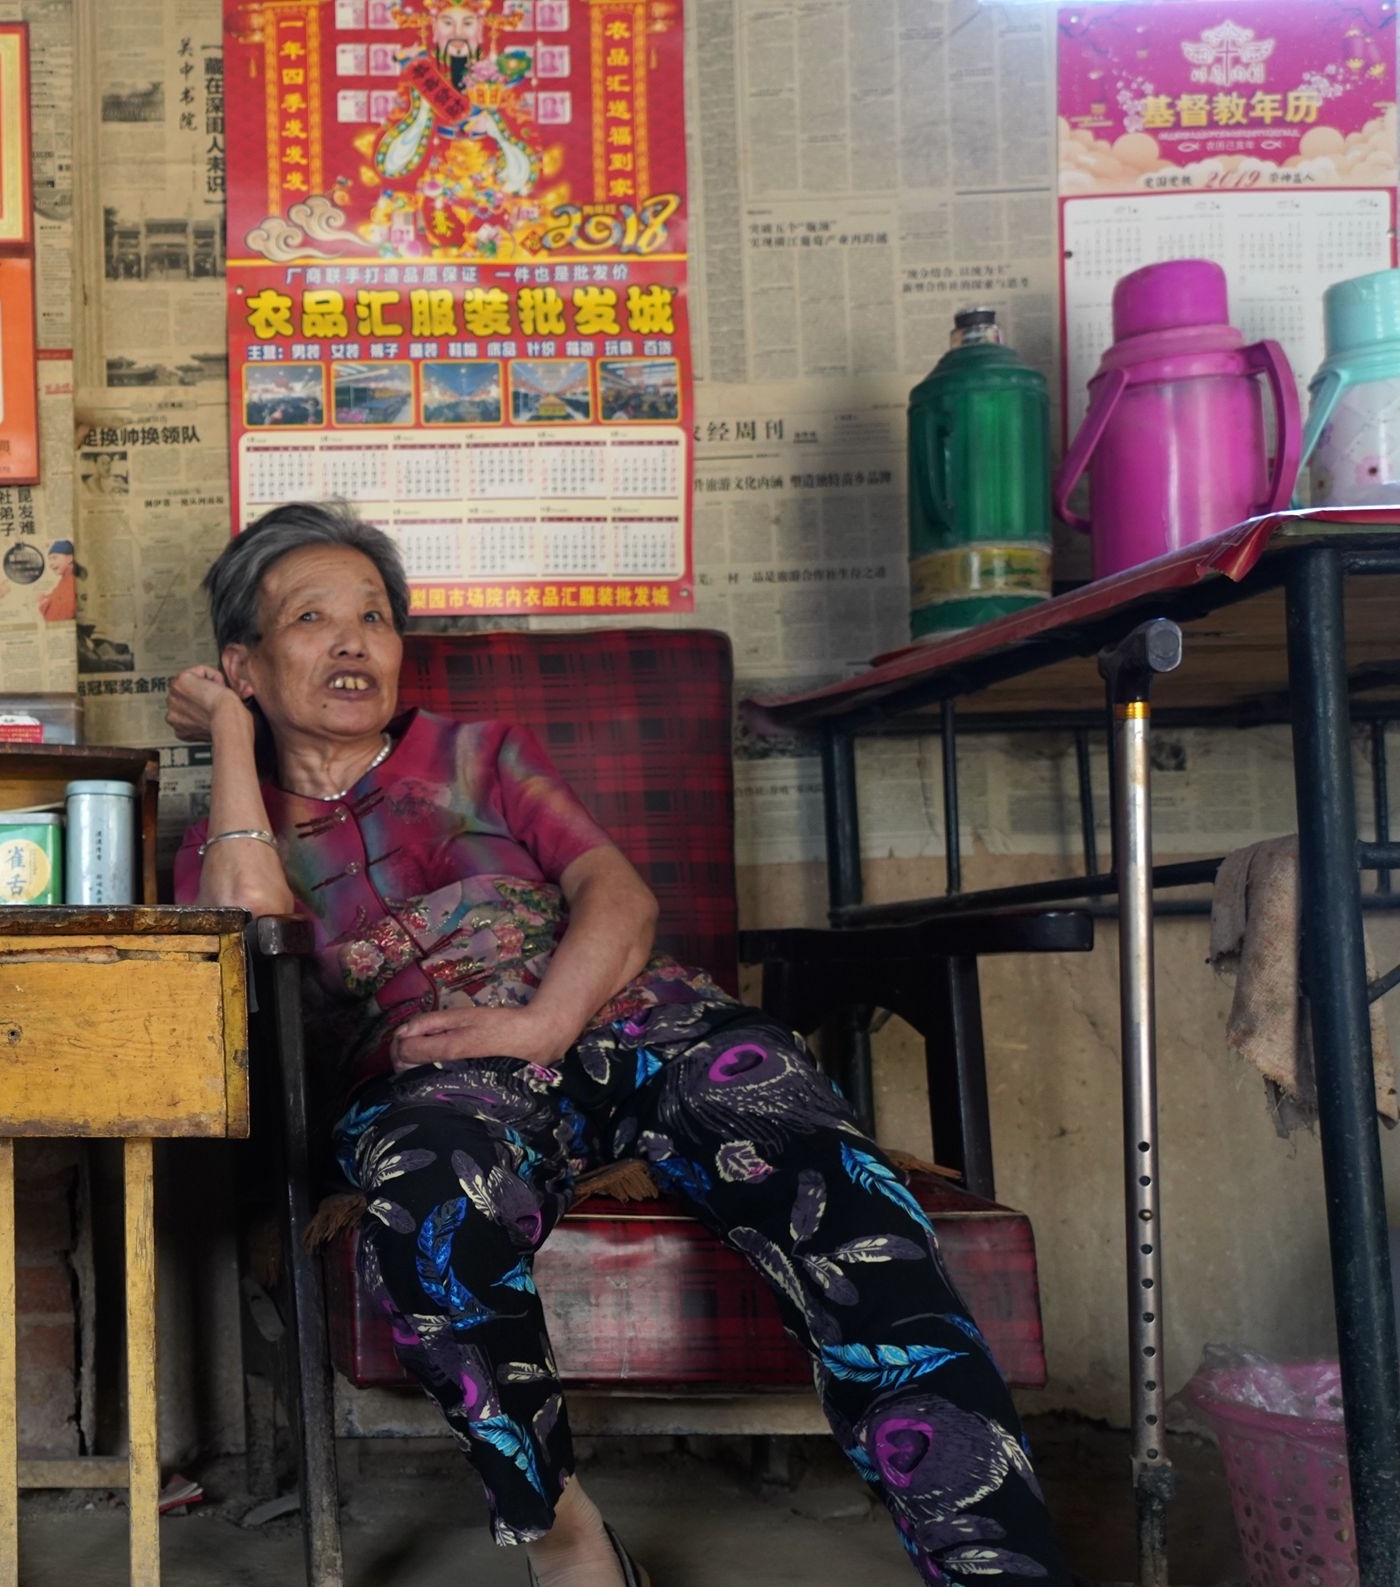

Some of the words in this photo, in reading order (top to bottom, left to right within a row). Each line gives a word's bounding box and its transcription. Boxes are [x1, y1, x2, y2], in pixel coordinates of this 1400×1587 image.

[280, 20, 308, 192] 一年四季发发发
[605, 20, 634, 197] 衣品汇送福到家
[1141, 91, 1318, 129] 基督教年历
[1203, 170, 1262, 189] 2019
[542, 193, 681, 256] 2018
[286, 267, 478, 283] 厂商联手打造品质保证
[495, 263, 628, 281] 一件也是批发价
[246, 285, 677, 340] 衣品汇服装批发城
[409, 586, 670, 609] 梨园市场院内衣品汇服装批发城
[7, 846, 27, 898] 雀舌
